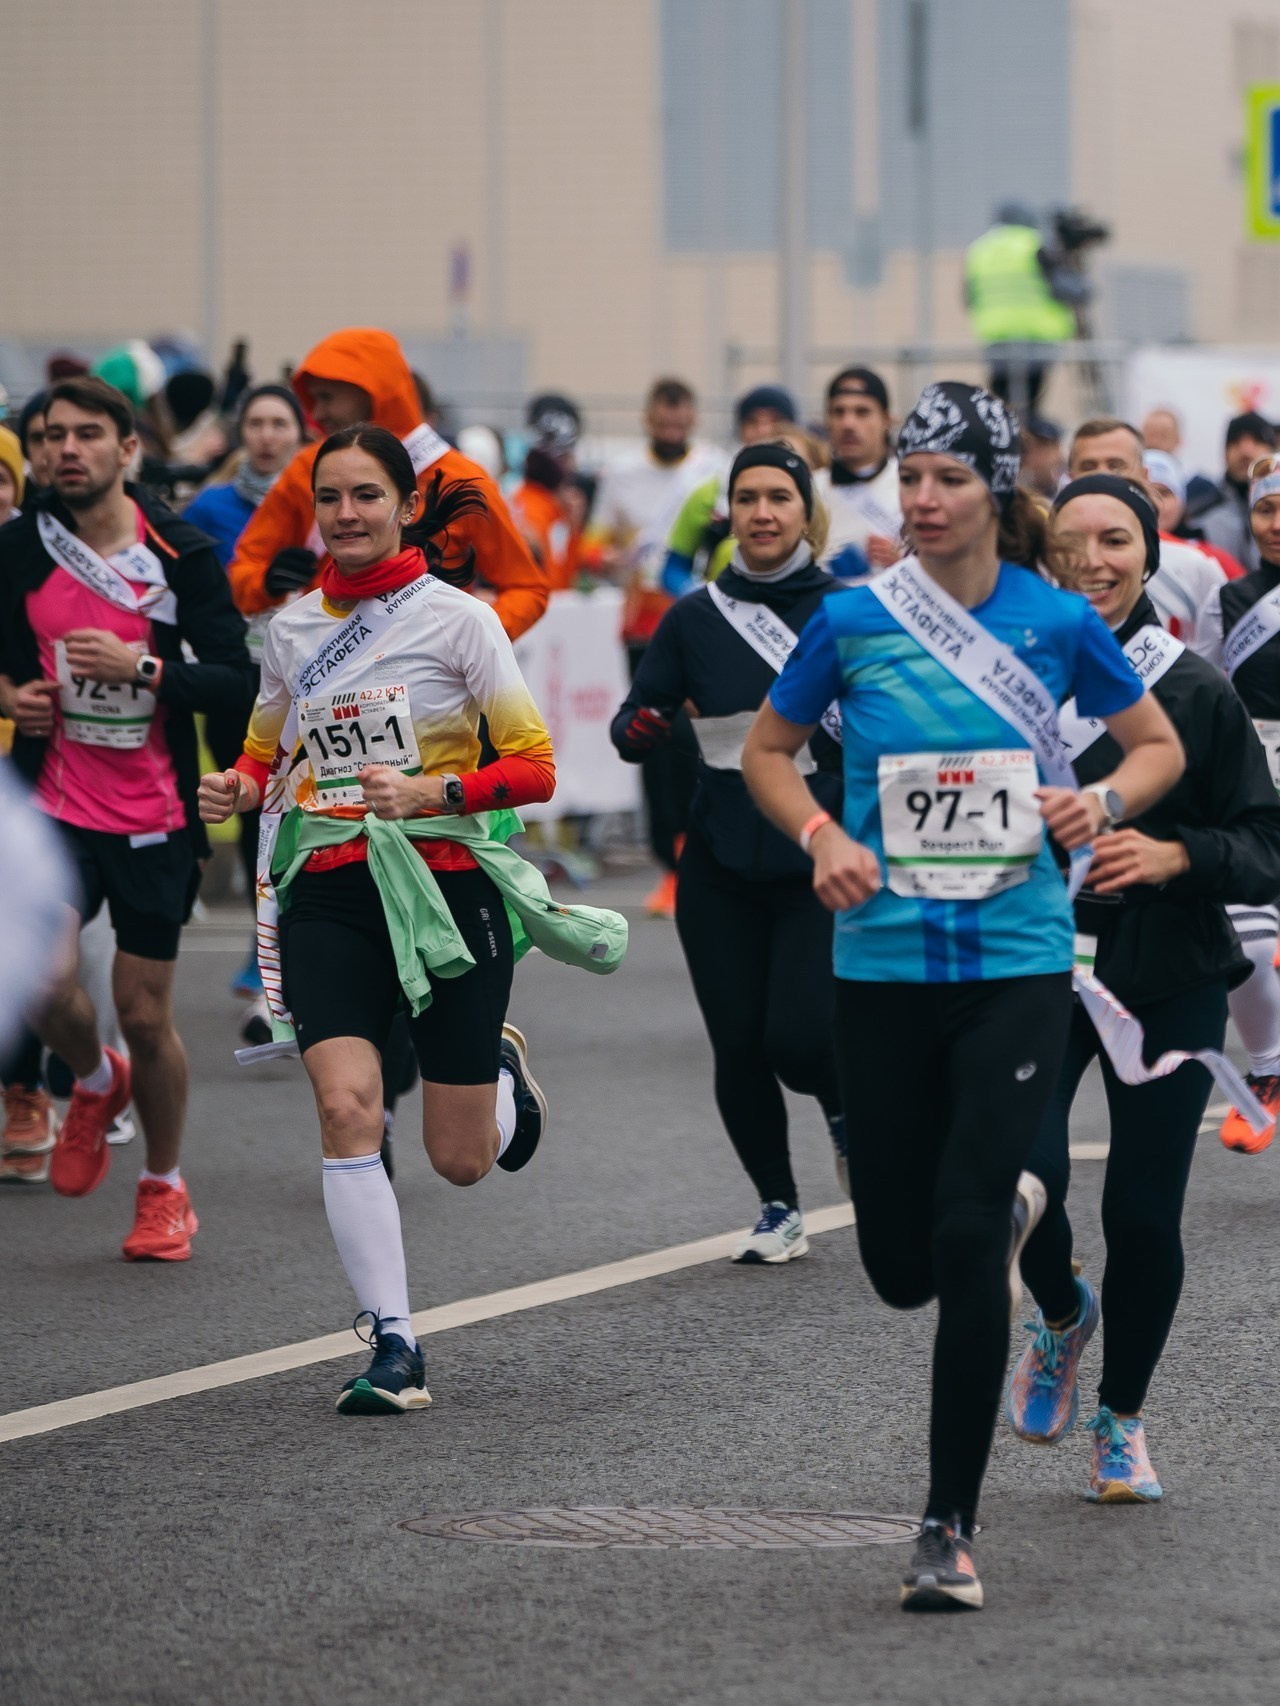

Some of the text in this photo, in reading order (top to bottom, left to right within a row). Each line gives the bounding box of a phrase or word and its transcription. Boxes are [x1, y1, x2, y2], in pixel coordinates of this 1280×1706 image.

[385, 575, 438, 615] ОРАТИВНАЯ
[881, 576, 964, 660] ЭСТАФЕТА
[299, 614, 363, 685] КОРПОРАТИВНАЯ
[302, 625, 372, 696] ЭСТАФЕТА
[360, 688, 383, 701] 42,2
[308, 715, 405, 760] 151-1
[320, 765, 353, 778] Диагноз
[906, 789, 1009, 832] 97-1
